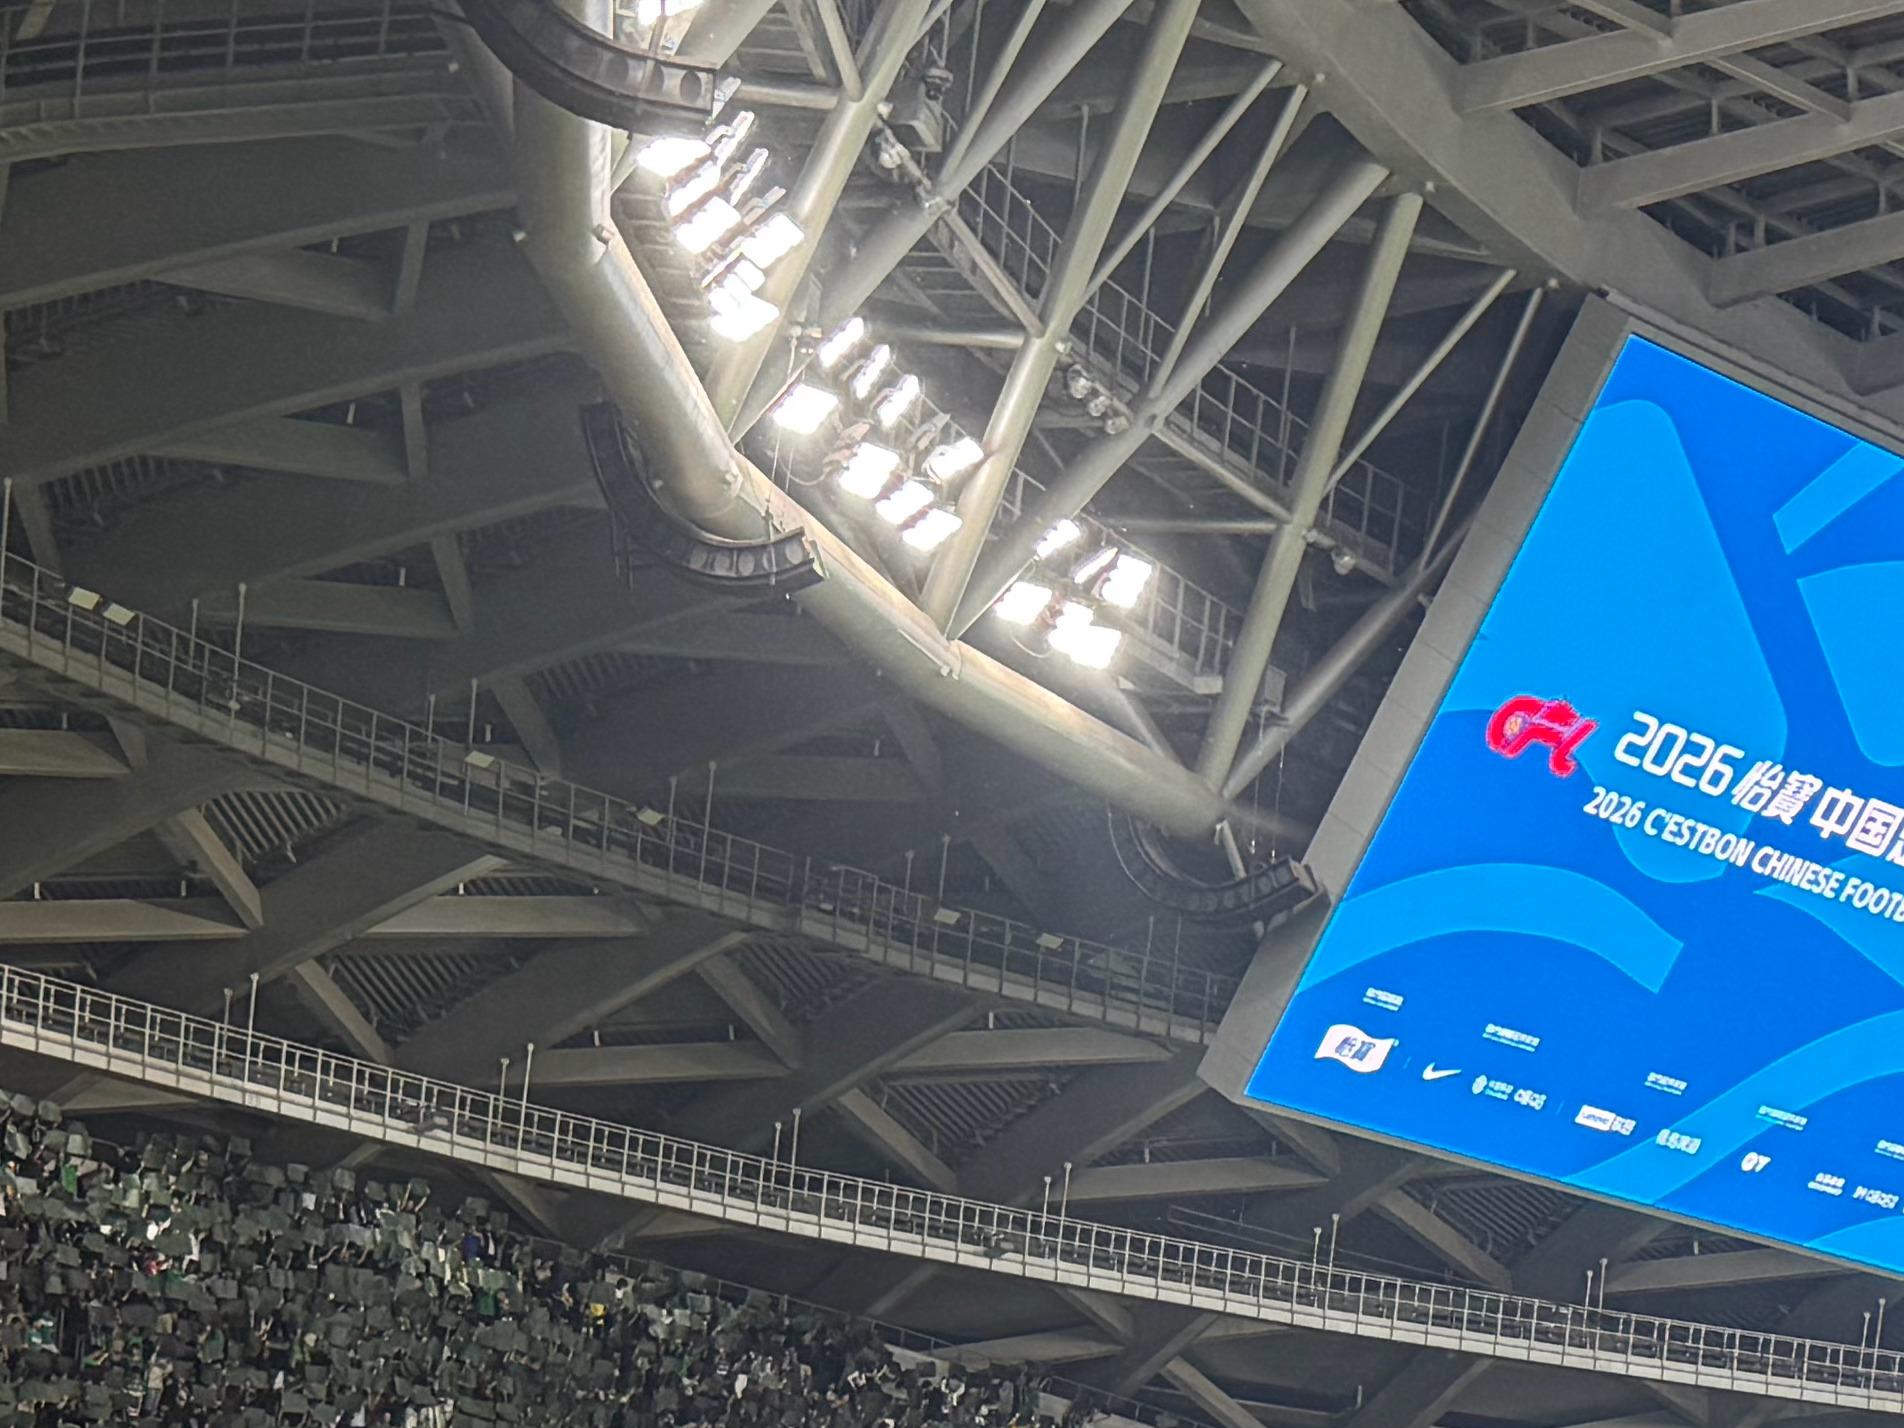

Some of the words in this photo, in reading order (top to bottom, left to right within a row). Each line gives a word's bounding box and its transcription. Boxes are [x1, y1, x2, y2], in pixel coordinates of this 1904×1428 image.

[1614, 710, 1745, 797] 2026
[1583, 786, 1646, 828] 2026
[1643, 808, 1756, 868] C'ESTBON
[1750, 846, 1845, 900] CHINESE
